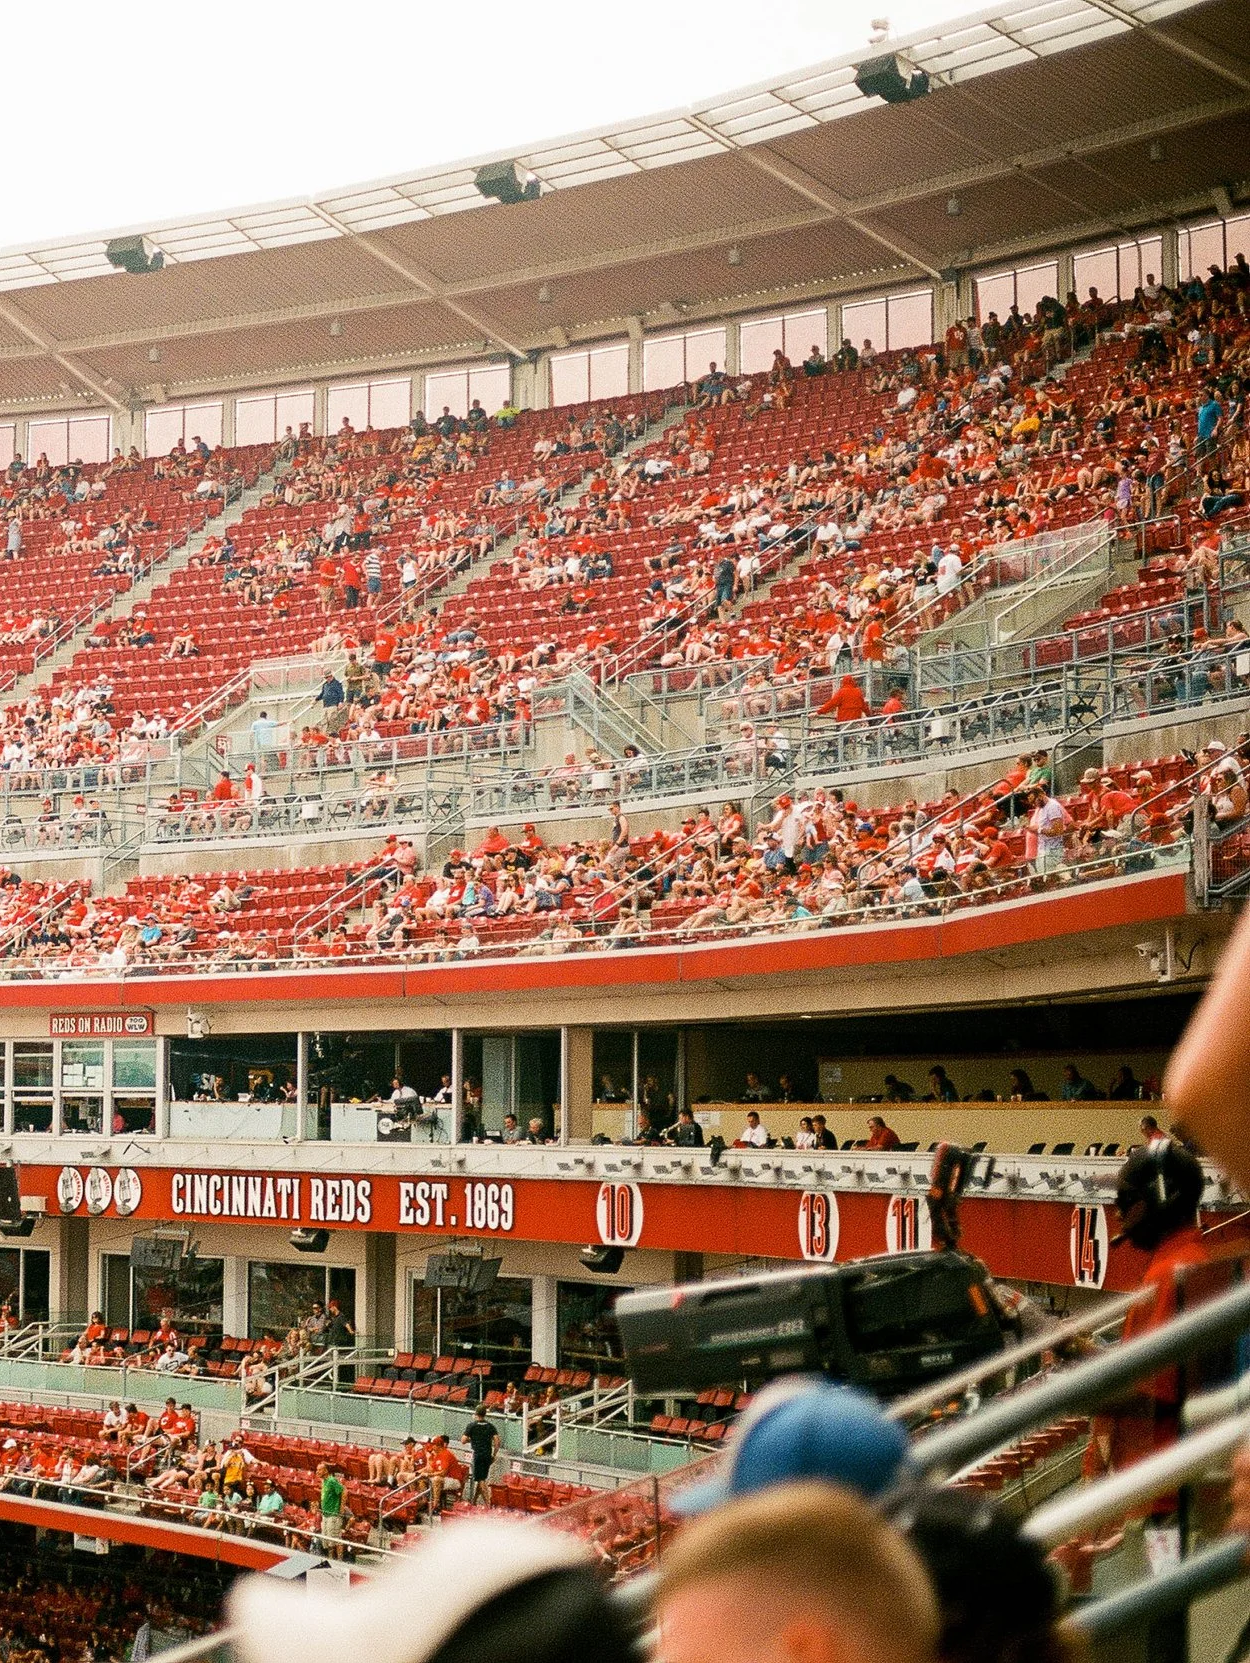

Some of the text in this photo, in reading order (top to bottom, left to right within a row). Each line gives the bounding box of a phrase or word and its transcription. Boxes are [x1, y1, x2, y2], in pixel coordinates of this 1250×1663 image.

[52, 1016, 123, 1034] REDS ON RADIO
[171, 1173, 514, 1231] CINCINNATI REDS EST. 1869
[602, 1184, 634, 1241] 10
[801, 1193, 831, 1257] 13
[892, 1197, 919, 1252] 11
[1071, 1207, 1101, 1284] 14
